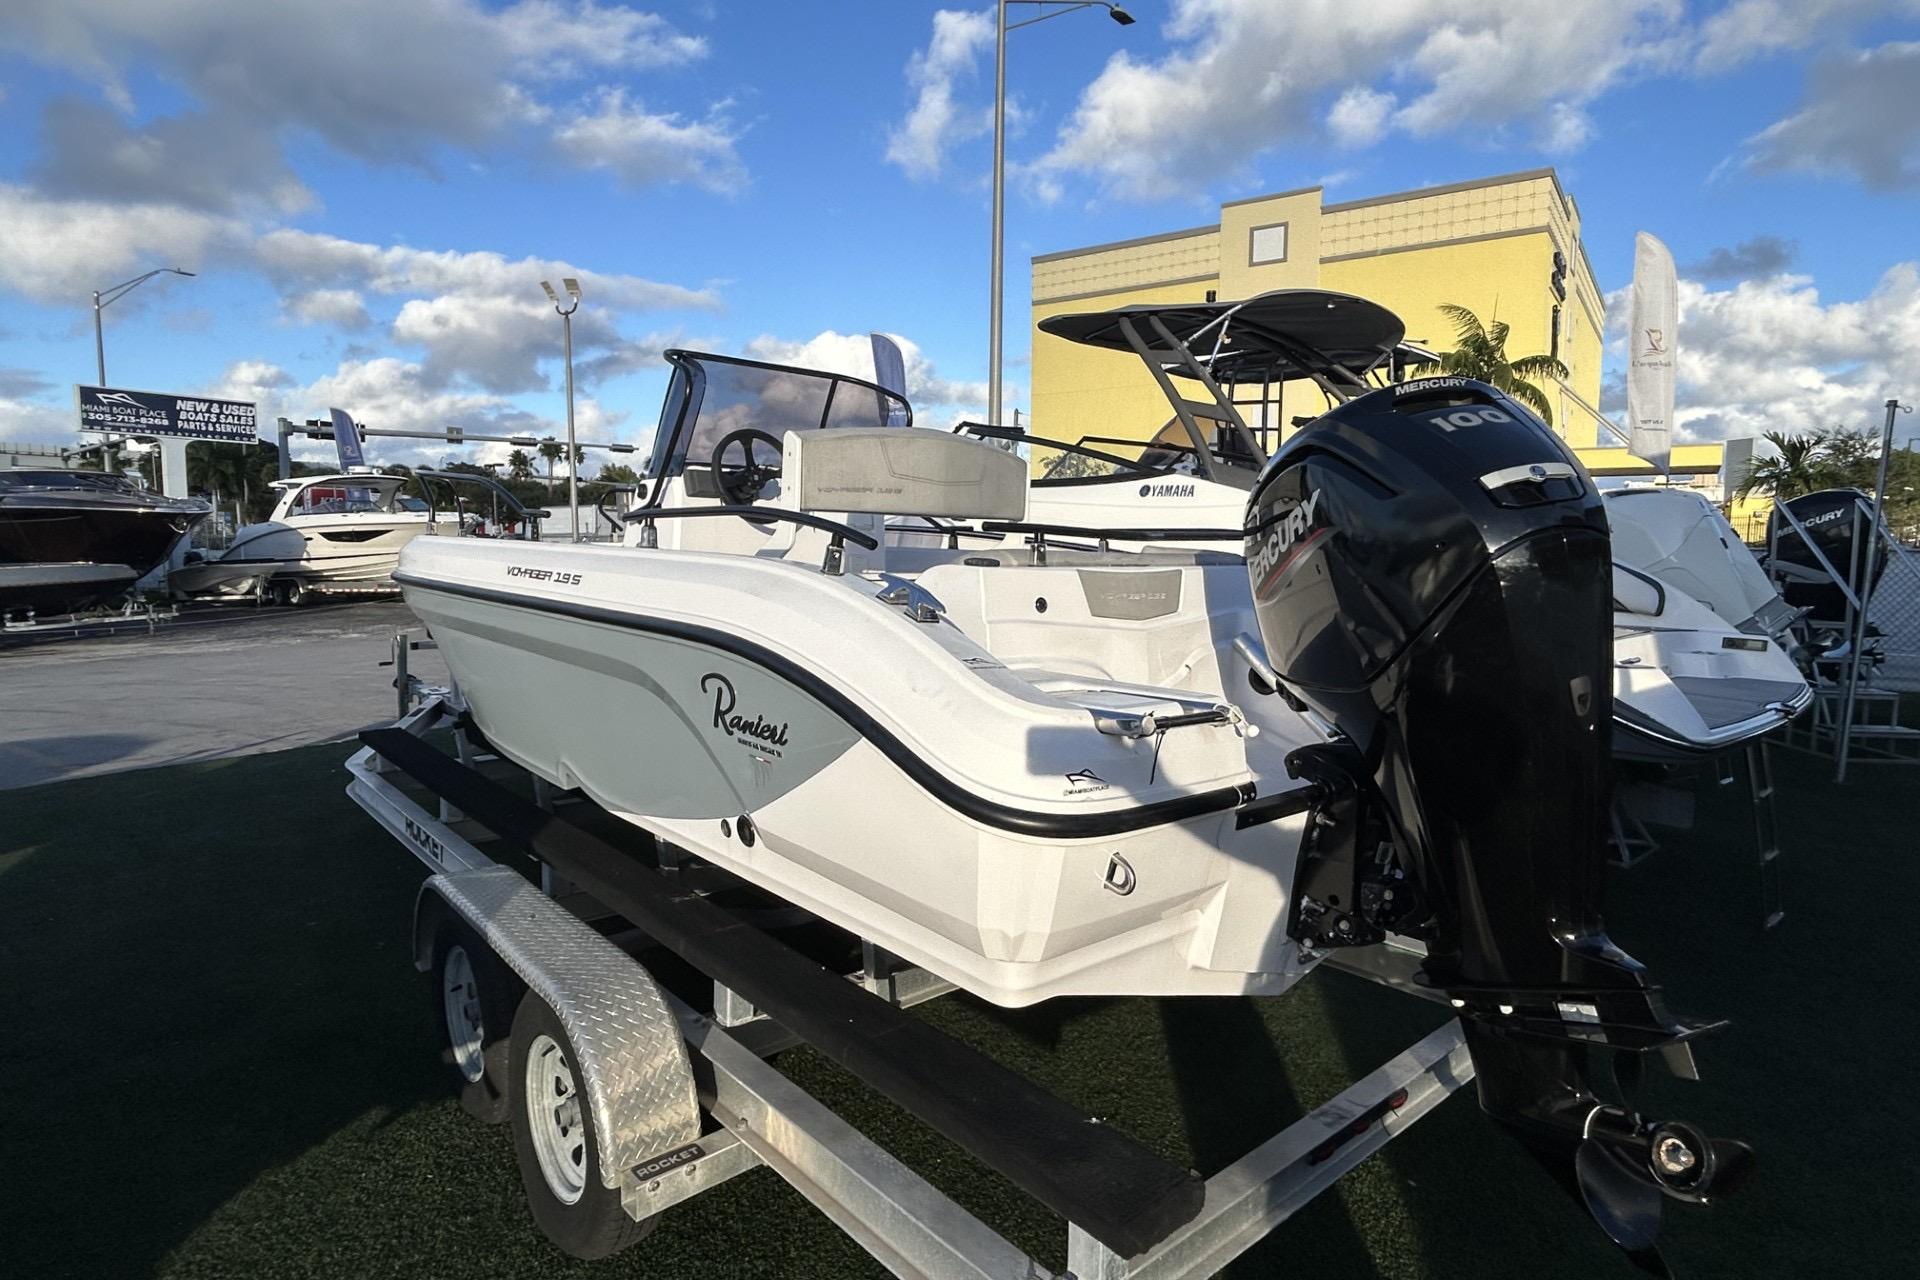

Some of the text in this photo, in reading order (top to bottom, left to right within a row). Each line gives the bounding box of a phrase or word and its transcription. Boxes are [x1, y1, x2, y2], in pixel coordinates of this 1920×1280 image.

[1395, 379, 1467, 396] MERCURY
[81, 404, 167, 418] MIAMI BOAT PLACE
[176, 400, 256, 417] NEW & USED
[88, 412, 169, 426] 305-713-8268
[179, 411, 253, 425] BOATS SALES
[1430, 410, 1513, 432] 100
[177, 421, 256, 434] PARTS & SERVICES
[1152, 485, 1195, 497] YAMAHA
[1776, 508, 1844, 538] MECURY
[507, 566, 553, 581] VOYAGER
[701, 672, 788, 746] Ranieri
[405, 816, 444, 864] ROCKET
[636, 1147, 699, 1177] ROCKET
